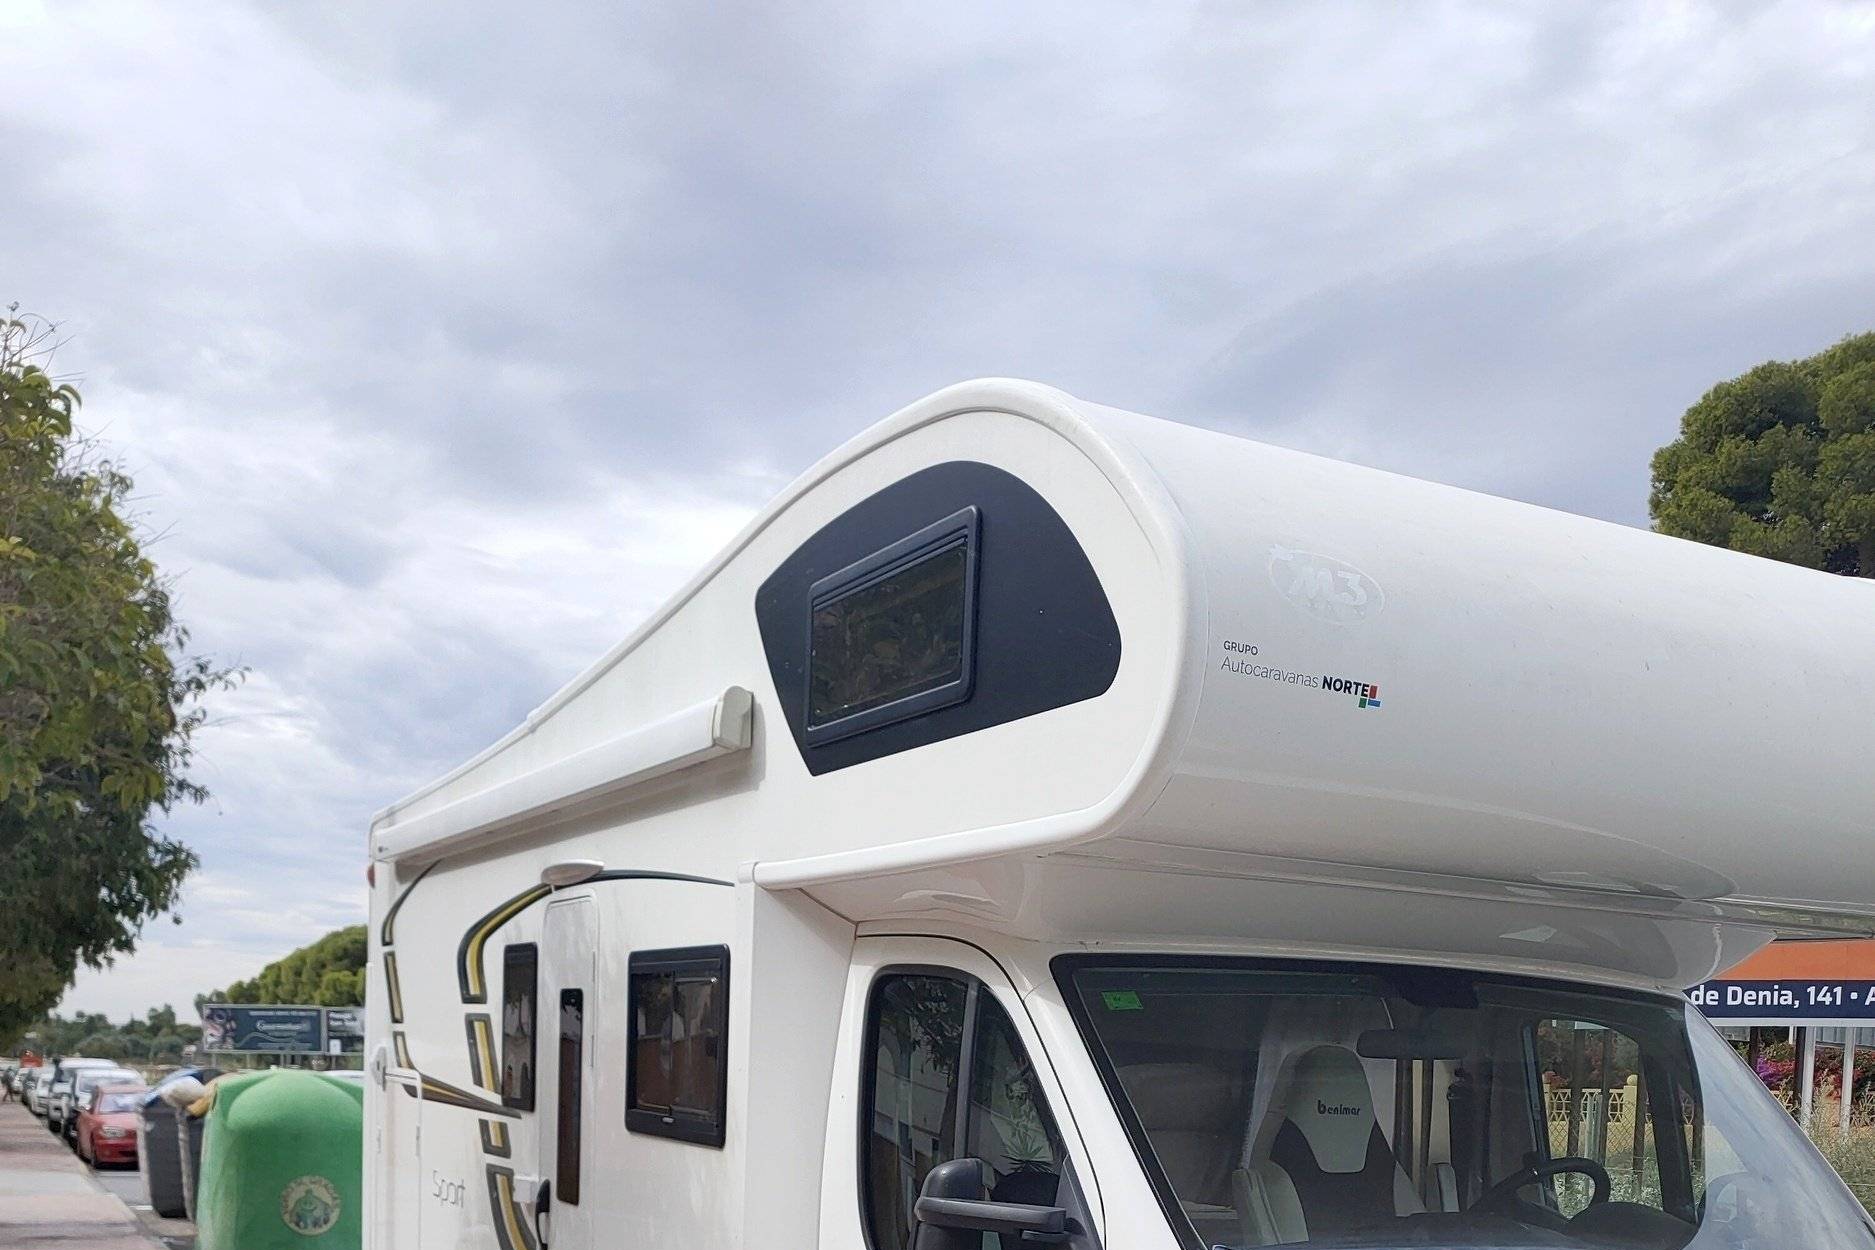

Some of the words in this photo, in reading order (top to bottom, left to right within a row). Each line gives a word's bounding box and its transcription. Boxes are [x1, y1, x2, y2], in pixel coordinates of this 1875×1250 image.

[1223, 640, 1259, 656] GRUPO
[1220, 655, 1319, 688] Autocaravanas
[1321, 675, 1370, 698] NORTE
[1690, 985, 1719, 1006] de
[1726, 985, 1800, 1009] Denia,
[1806, 986, 1842, 1006] 141
[1317, 1099, 1361, 1116] benimar
